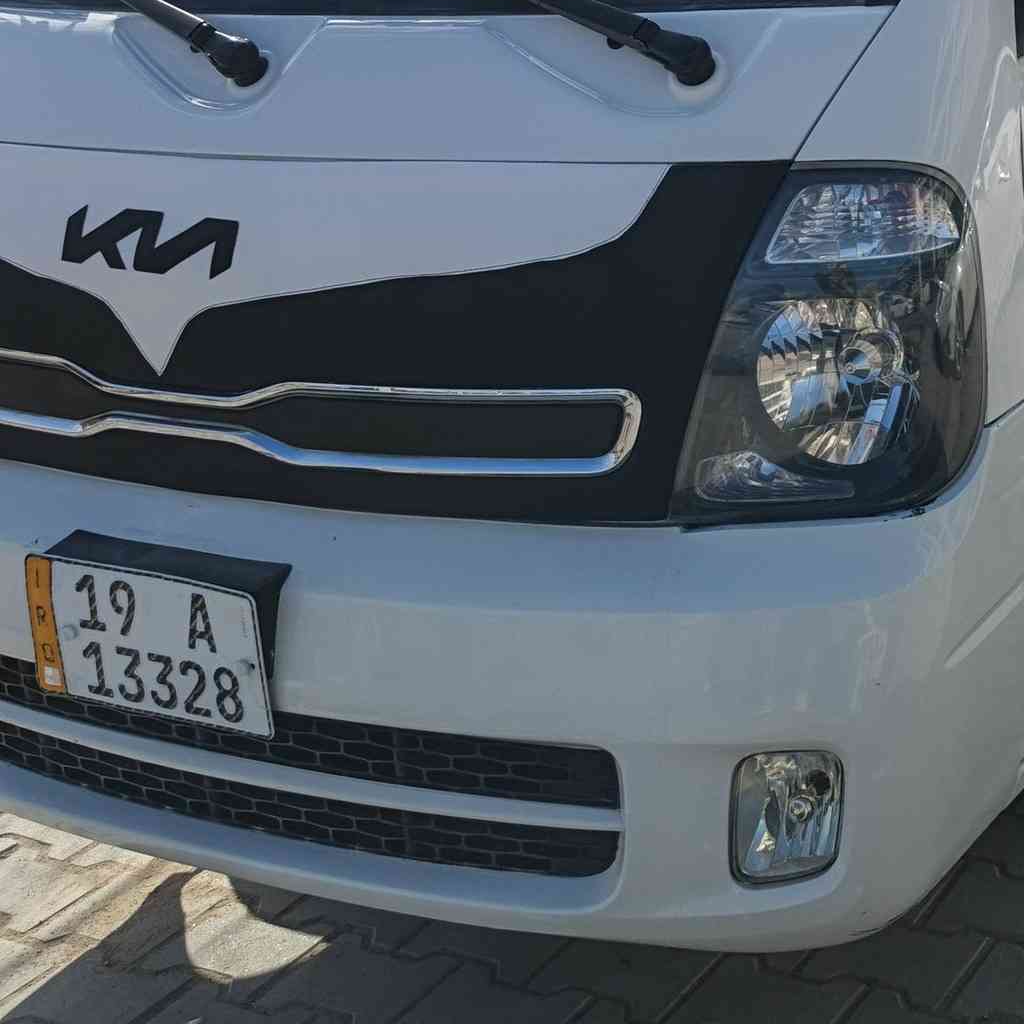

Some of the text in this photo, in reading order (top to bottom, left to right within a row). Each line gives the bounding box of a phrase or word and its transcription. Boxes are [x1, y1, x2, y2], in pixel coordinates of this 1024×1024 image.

[75, 574, 136, 636] 19
[188, 593, 216, 653] A
[82, 641, 244, 723] 13328
